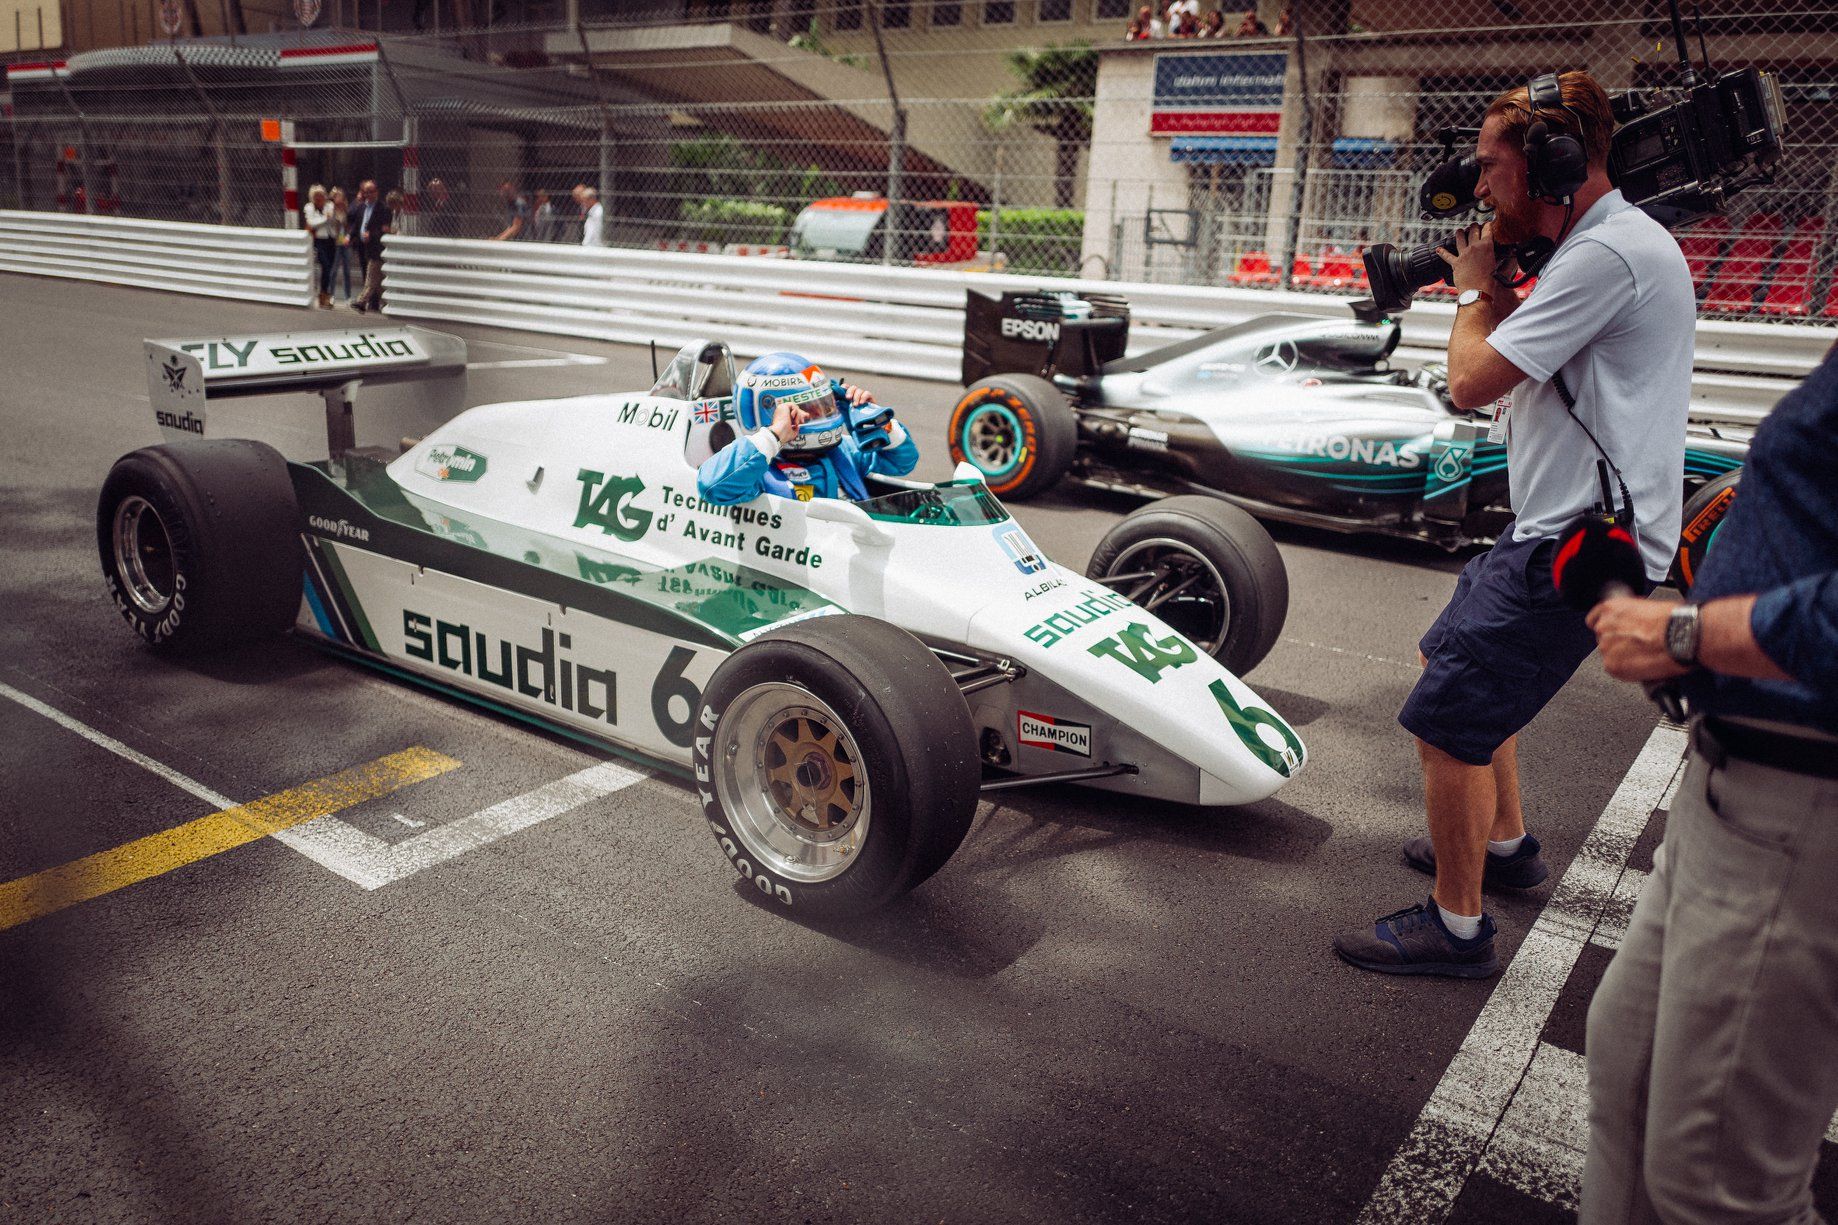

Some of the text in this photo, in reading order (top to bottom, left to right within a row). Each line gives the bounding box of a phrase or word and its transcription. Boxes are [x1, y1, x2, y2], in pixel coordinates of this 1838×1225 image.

[269, 333, 414, 365] saudia
[1002, 317, 1061, 341] EPSON
[156, 409, 205, 436] saudia
[617, 402, 679, 432] Mobil
[572, 467, 654, 543] TAG
[683, 519, 746, 552] Avant
[755, 535, 823, 569] Garde
[1023, 589, 1134, 649] saudia
[402, 609, 618, 727] saudia
[651, 645, 702, 749] 6
[1021, 721, 1088, 747] CHAMPION
[1207, 678, 1305, 779] 6
